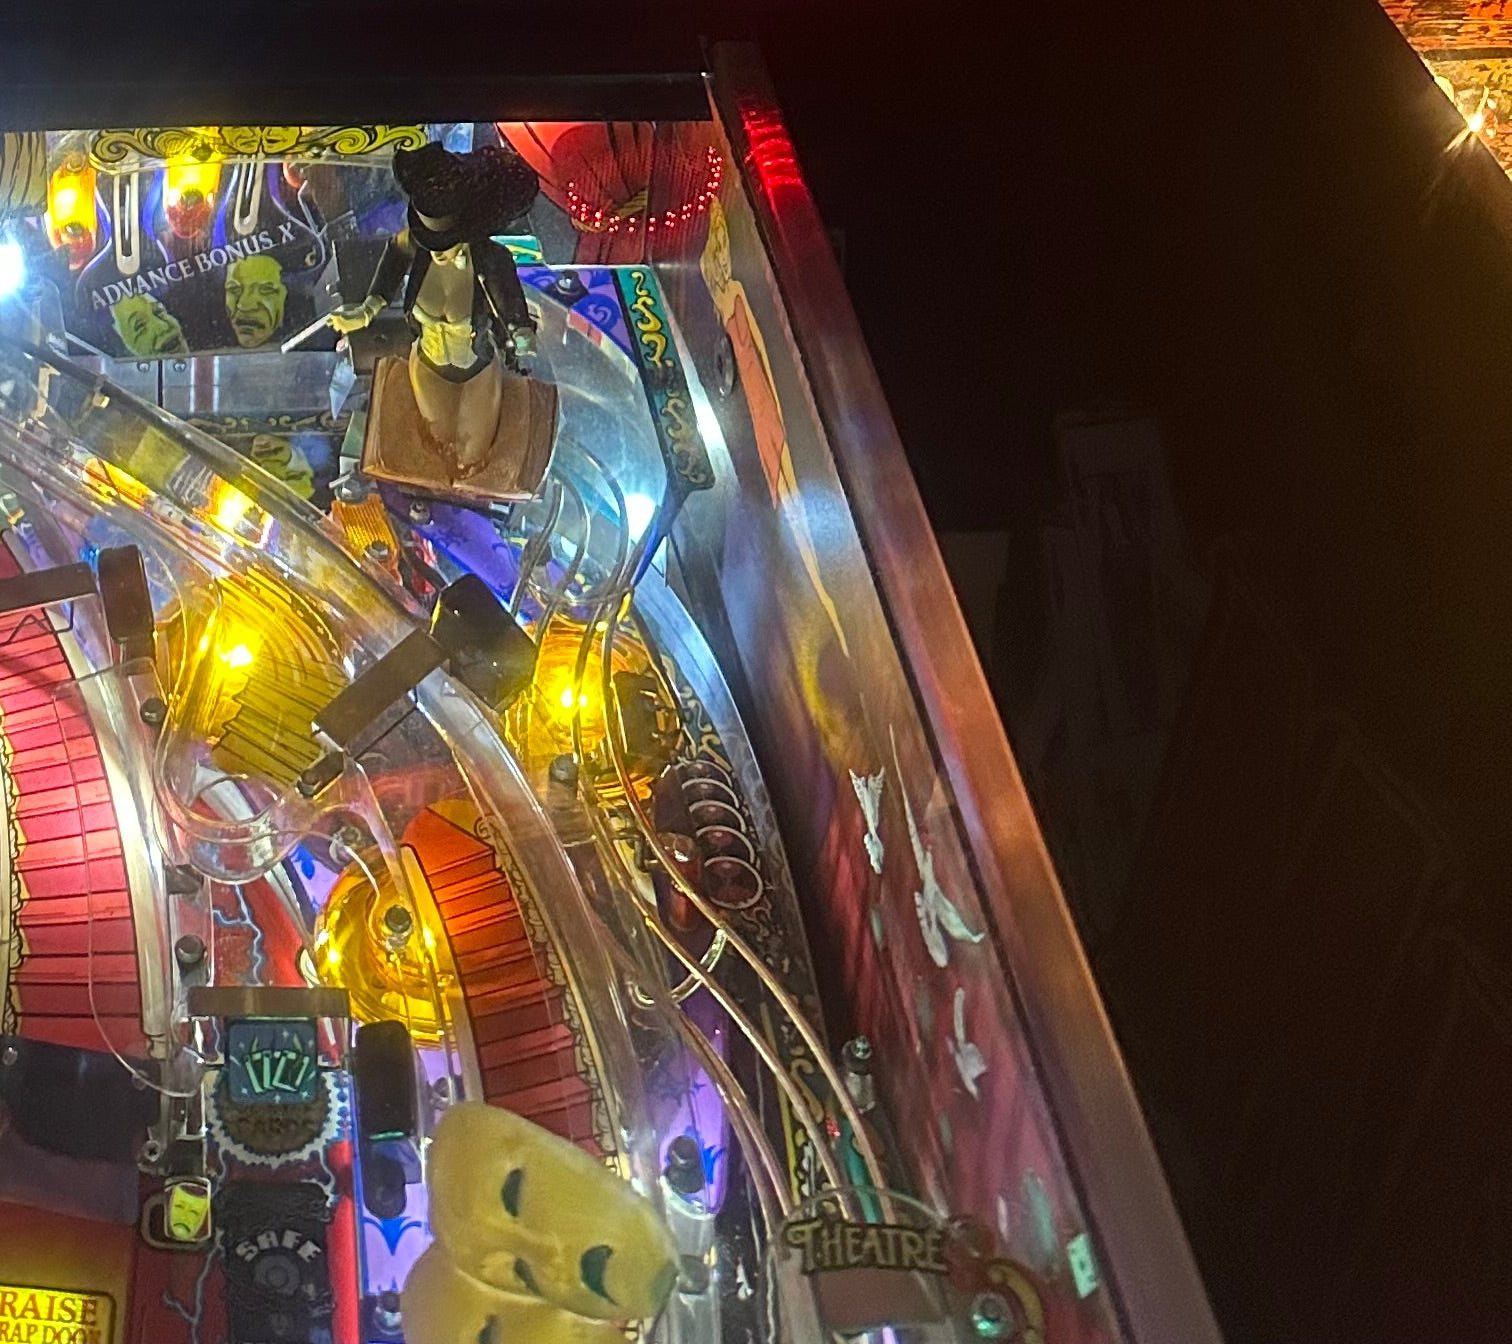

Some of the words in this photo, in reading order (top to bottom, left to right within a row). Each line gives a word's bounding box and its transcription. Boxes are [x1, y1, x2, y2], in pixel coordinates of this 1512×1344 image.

[90, 261, 195, 310] ADVANCE
[194, 230, 276, 274] BONUS
[278, 222, 297, 245] X
[235, 1228, 322, 1263] SAFE
[786, 1219, 948, 1271] THEATRE
